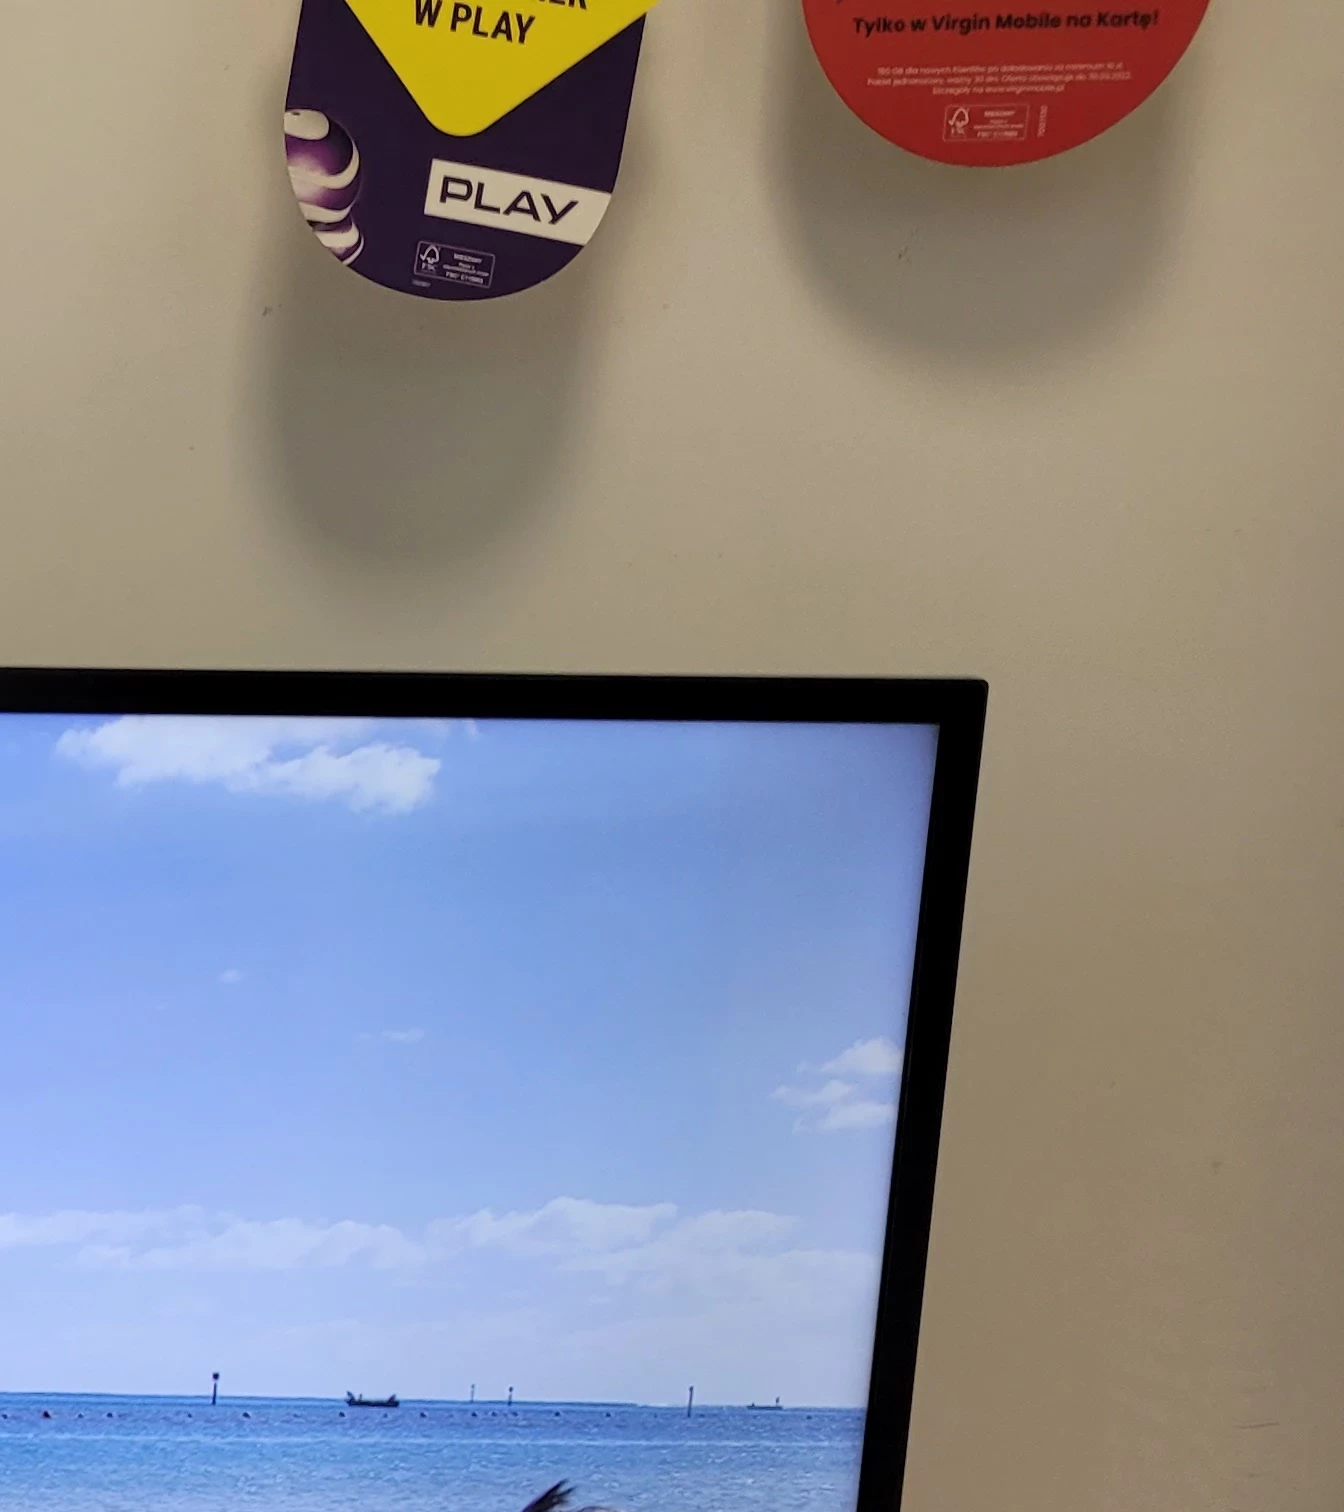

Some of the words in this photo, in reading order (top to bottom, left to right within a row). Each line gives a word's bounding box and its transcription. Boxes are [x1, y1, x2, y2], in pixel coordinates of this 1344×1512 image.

[415, 0, 442, 28] W
[450, 2, 535, 44] PLAY
[853, 16, 907, 37] Tylko
[911, 18, 925, 32] w
[932, 14, 990, 35] Virgin
[995, 13, 1062, 30] Mobile
[1066, 14, 1093, 28] na
[1097, 10, 1159, 31] Kartę!
[439, 176, 579, 225] PLAY
